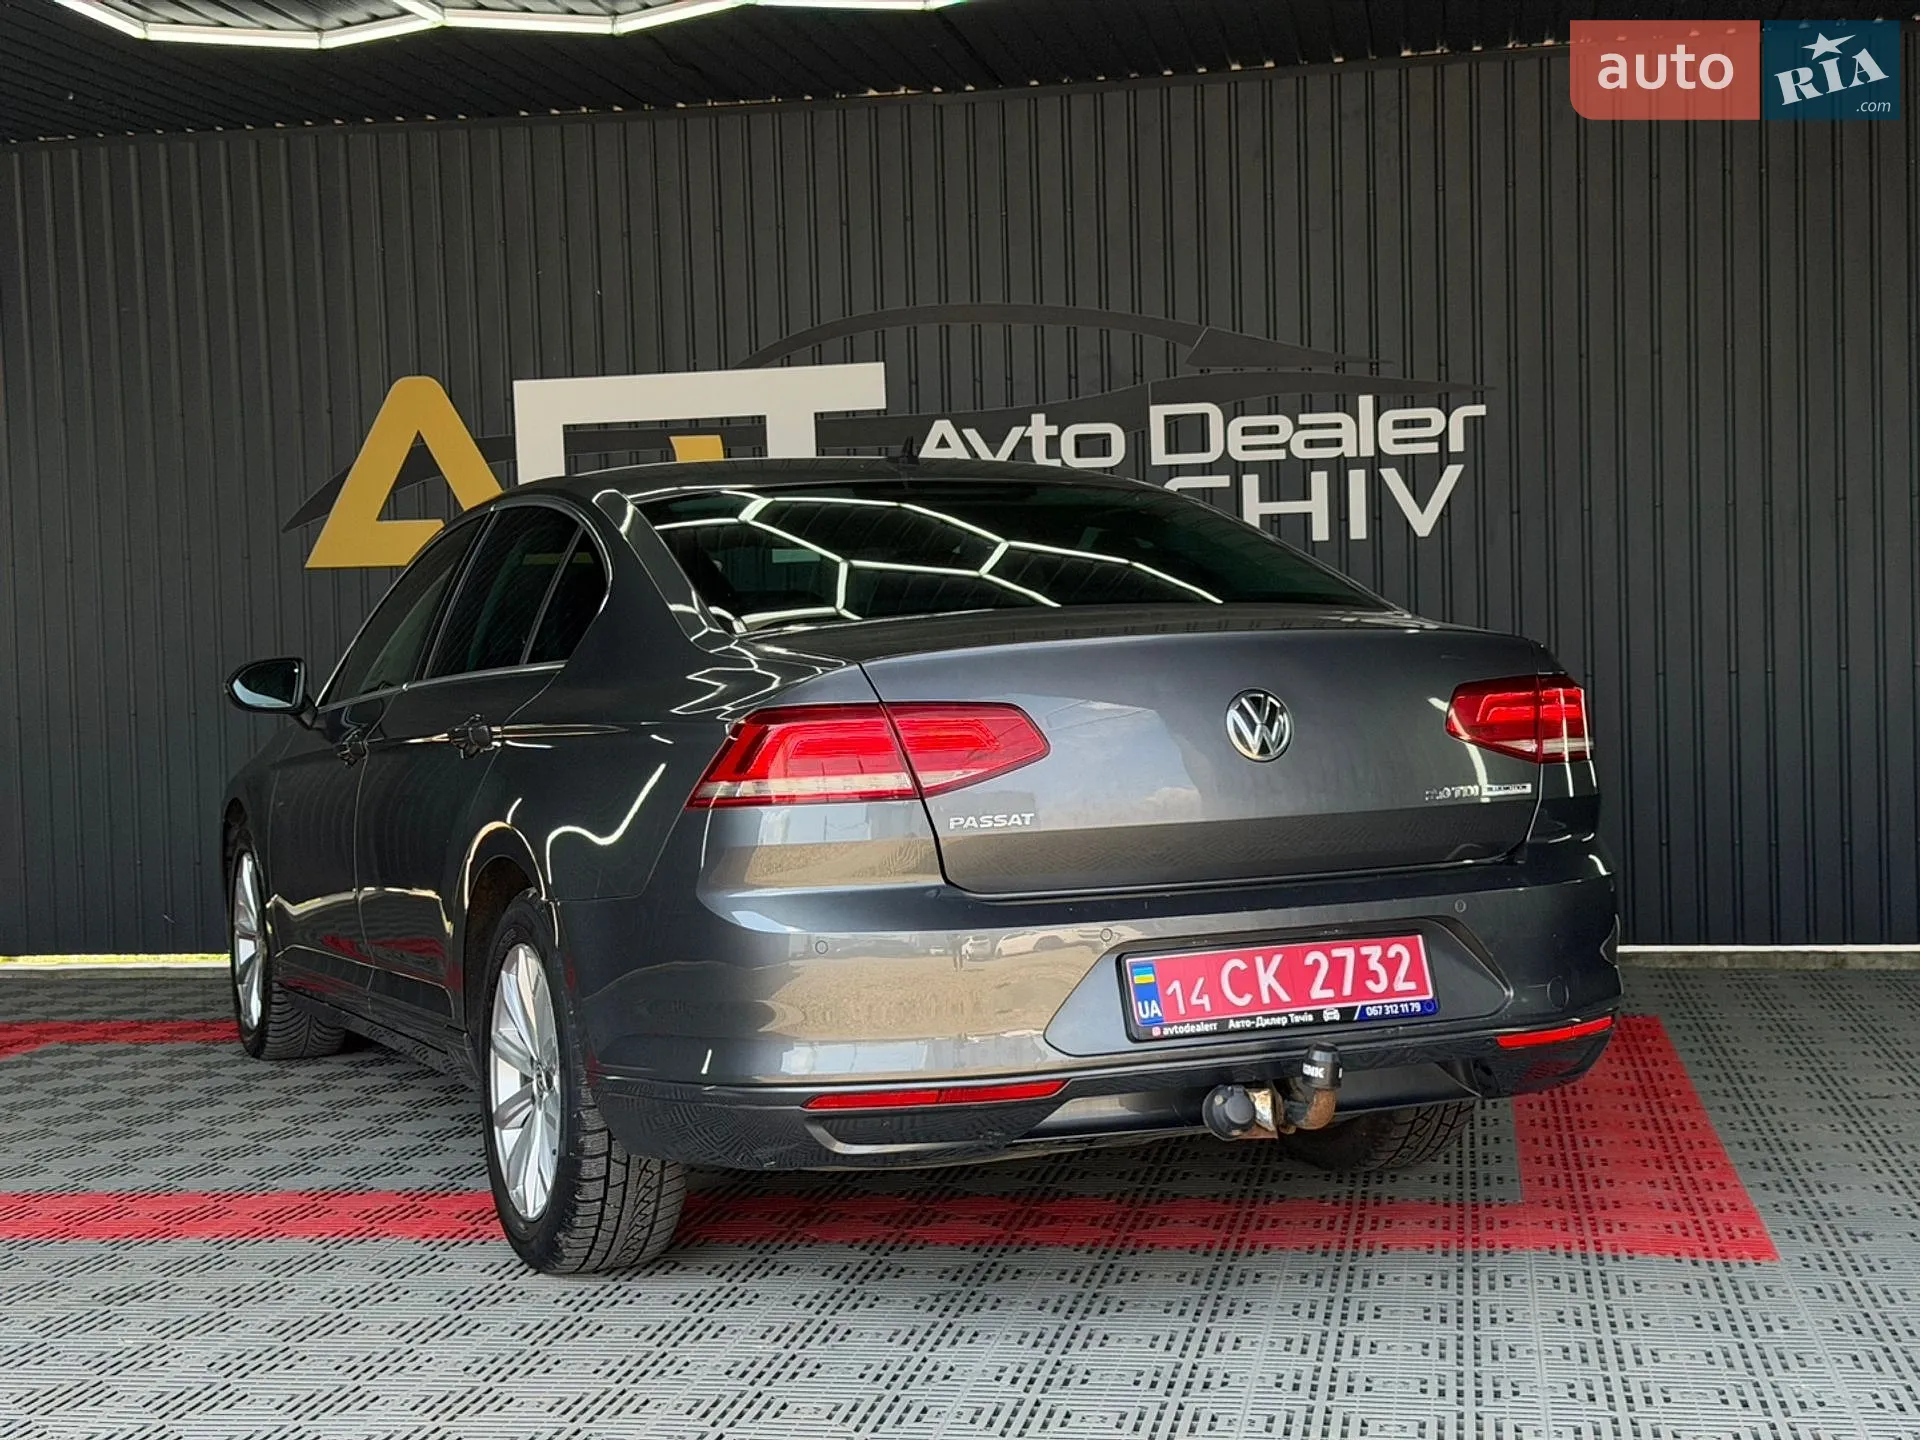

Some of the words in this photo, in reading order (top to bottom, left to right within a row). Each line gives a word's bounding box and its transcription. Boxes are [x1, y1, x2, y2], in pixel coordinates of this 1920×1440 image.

[918, 413, 1126, 468] Avto
[1150, 395, 1486, 465] Dealer
[949, 813, 1035, 829] PASSAT
[1166, 977, 1212, 1015] 14
[1220, 953, 1291, 1006] CK
[1304, 944, 1417, 1000] 2732
[1137, 1000, 1162, 1019] UA
[1384, 1004, 1399, 1015] 312
[1410, 1002, 1421, 1013] 79
